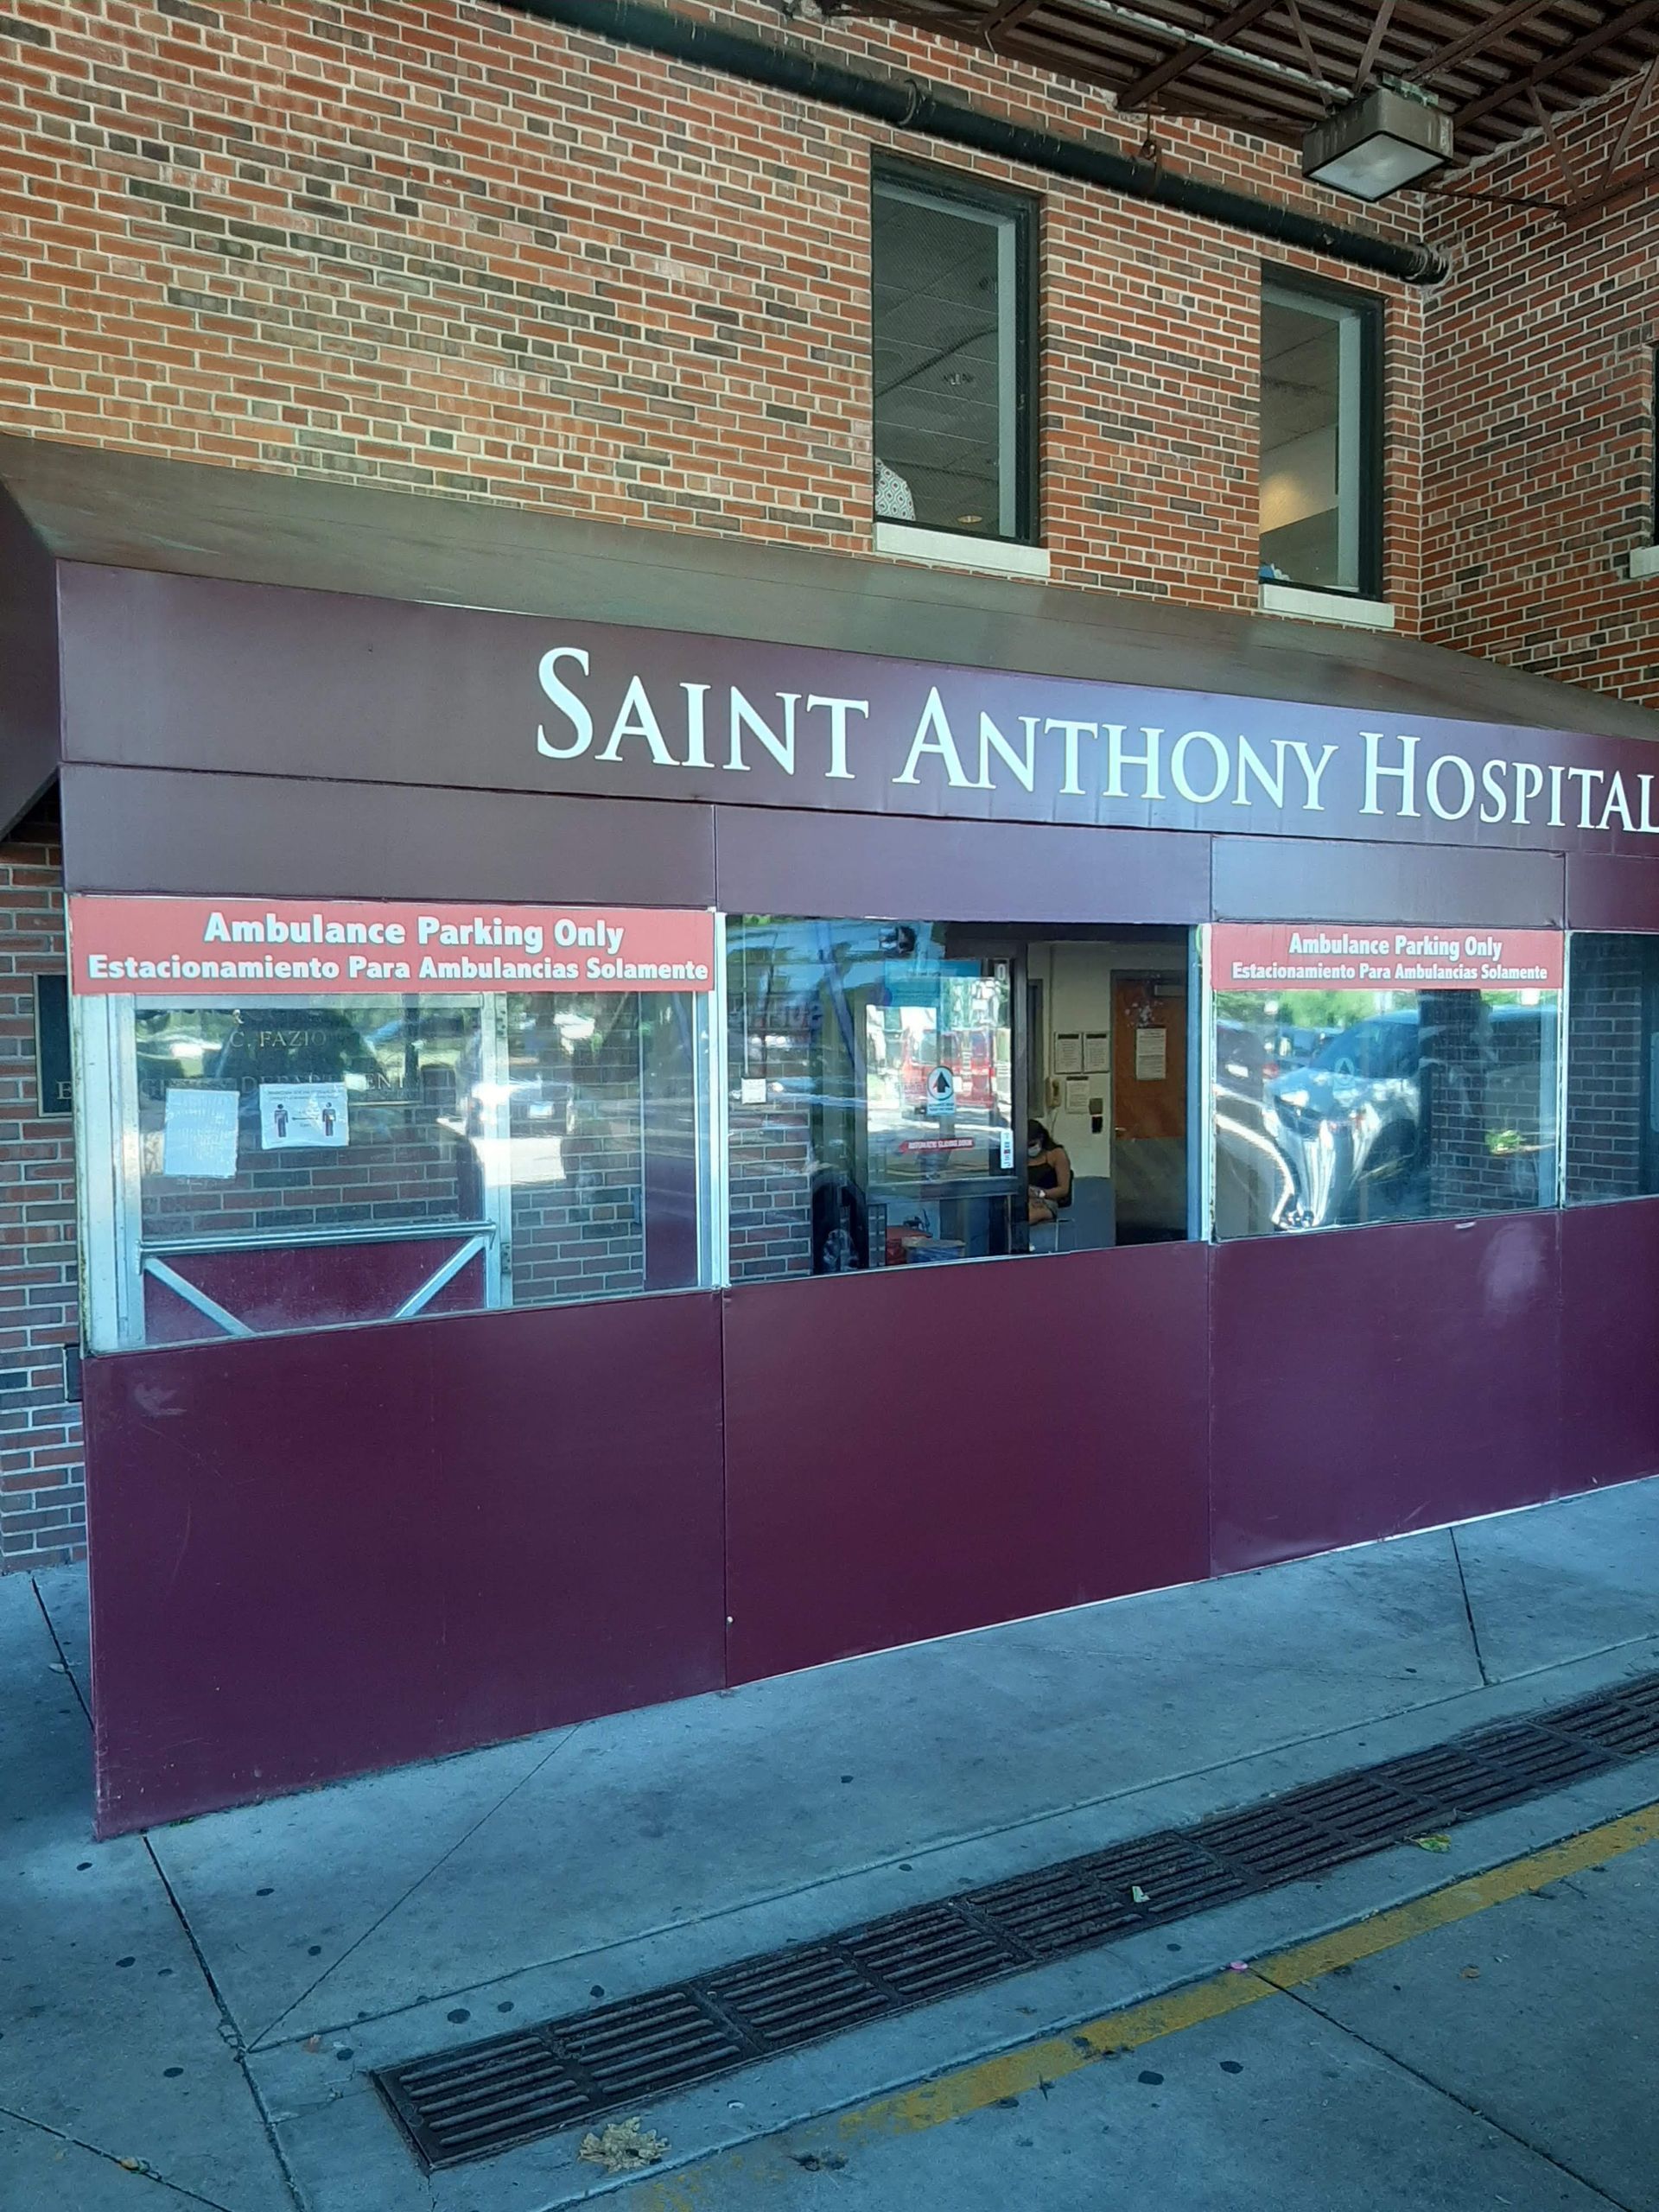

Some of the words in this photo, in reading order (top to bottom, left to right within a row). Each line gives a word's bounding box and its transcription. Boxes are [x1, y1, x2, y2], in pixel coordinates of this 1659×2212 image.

[537, 647, 869, 779] SAINT
[892, 686, 1338, 810] ANTHONY
[1358, 732, 1659, 834] HOSPITAL
[204, 912, 406, 944] Ambulance
[418, 916, 543, 954] Parking
[554, 918, 624, 955] Only
[1288, 932, 1389, 955] Ambulance
[1395, 934, 1460, 962] Parking
[1465, 936, 1503, 962] Only
[88, 954, 340, 979] Estacionamiento
[348, 955, 410, 979] Para
[418, 956, 579, 980] Ambulancias
[586, 957, 709, 980] Solamente
[1232, 962, 1355, 979] Estacionamiento
[1359, 963, 1391, 980] Para
[1395, 963, 1478, 980] Ambulancias
[1480, 963, 1548, 980] Solamente
[259, 1030, 327, 1048] FAZIO
